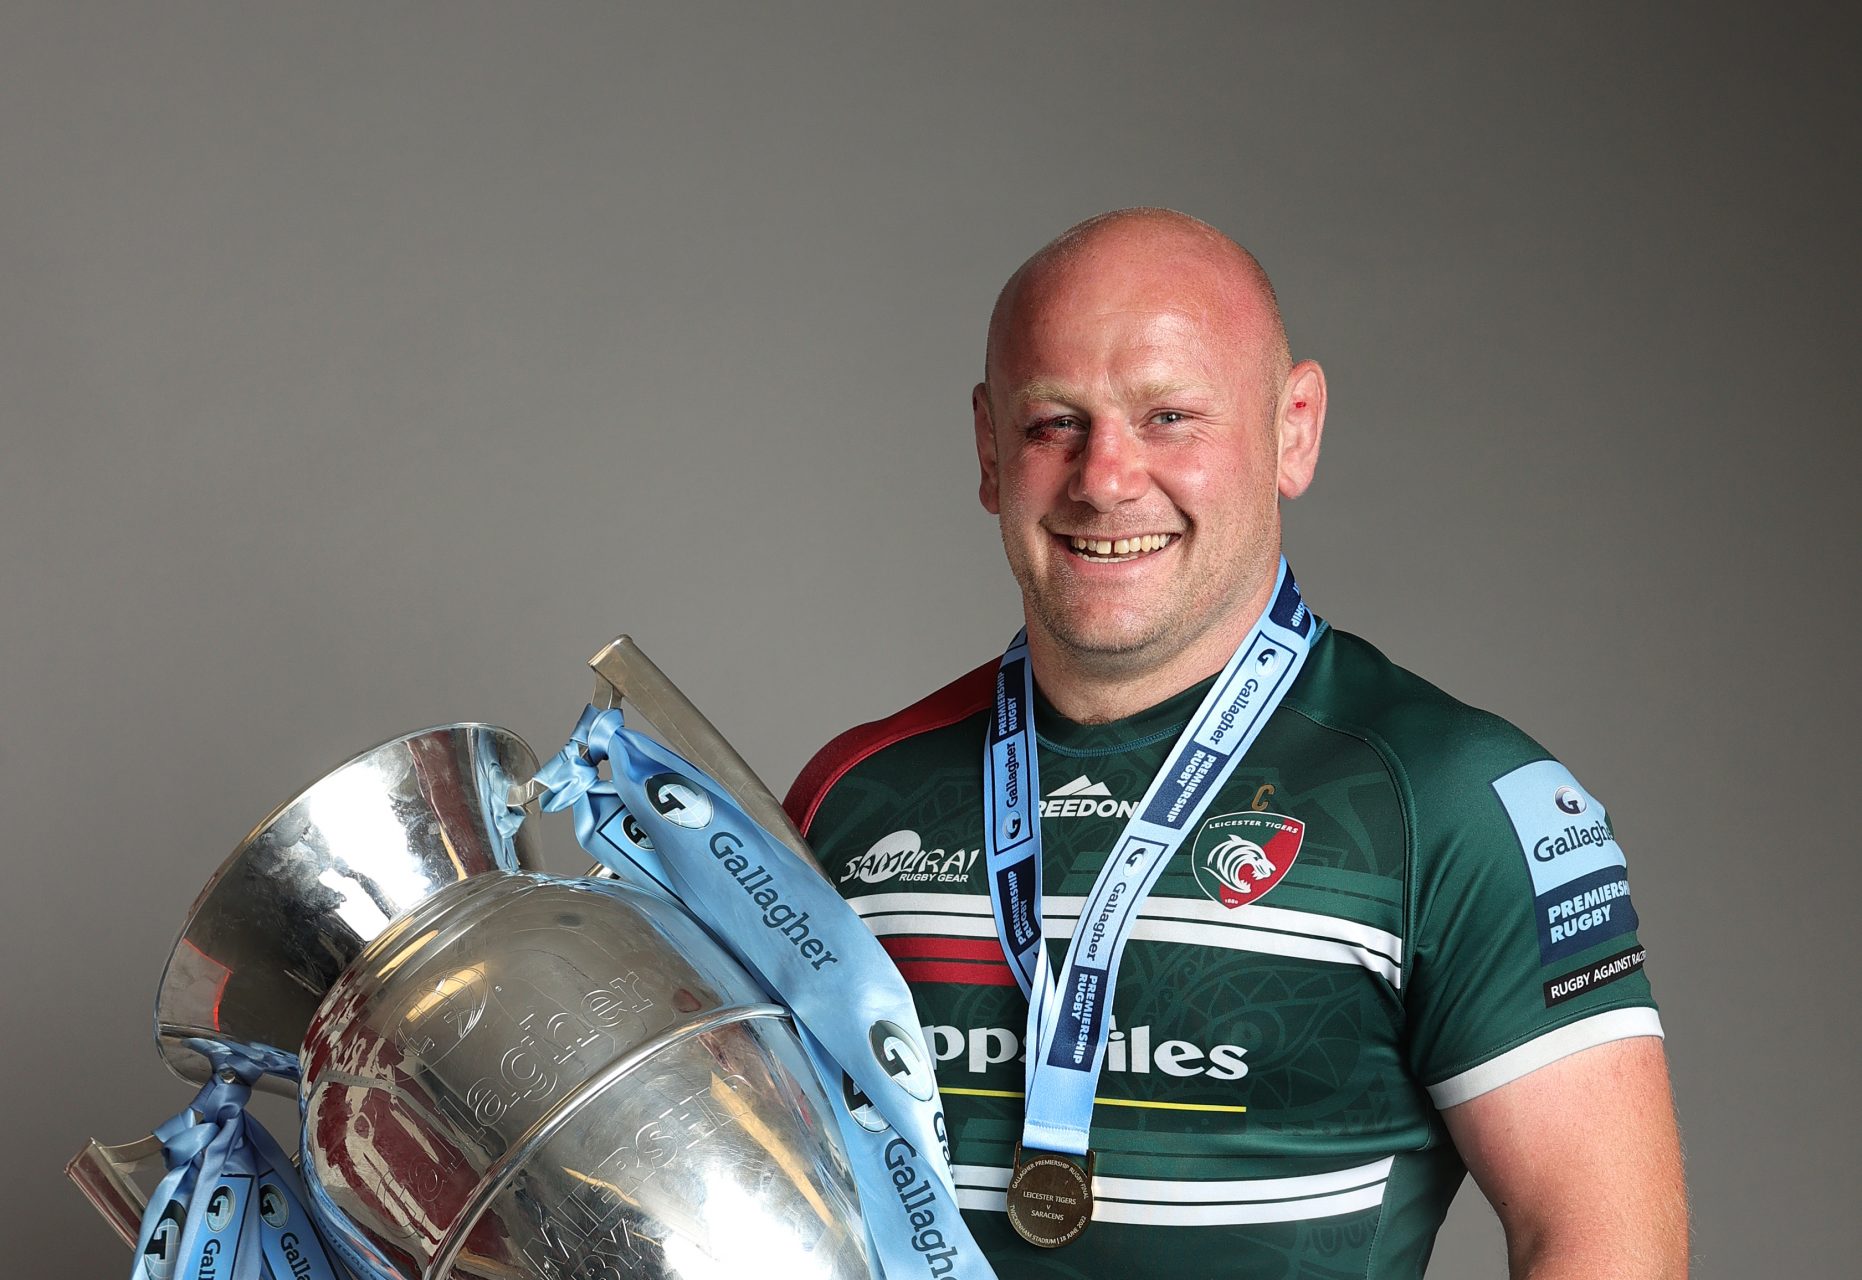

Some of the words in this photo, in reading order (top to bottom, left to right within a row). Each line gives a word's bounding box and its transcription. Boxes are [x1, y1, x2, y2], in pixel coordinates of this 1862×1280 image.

[997, 672, 1008, 736] PREMIERSHIP
[1007, 697, 1018, 732] RUGBY
[1209, 678, 1259, 745] Gallagher
[1005, 742, 1019, 808] Gallagher
[1176, 749, 1206, 787] RUGBY
[1038, 799, 1140, 818] REEDON
[1166, 754, 1218, 823] PREMIERSHIP
[1251, 784, 1276, 811] C
[1209, 820, 1262, 830] LEICESTER
[1265, 822, 1299, 834] TIGERS
[1533, 820, 1613, 862] Gallagh
[840, 848, 980, 883] SAMURAI
[898, 873, 937, 882] RUGBY
[937, 874, 969, 882] GEAR
[709, 831, 838, 970] Gallagher
[1008, 870, 1026, 946] PREMIERSHIP
[1020, 899, 1034, 939] RUGBY
[1086, 882, 1127, 962] Gallagher
[1549, 904, 1613, 944] RUGBY
[1071, 973, 1088, 1021] RUGBY
[1550, 972, 1591, 999] RUGBY
[1593, 956, 1632, 982] AGAINST
[1072, 975, 1098, 1064] PREMIERSHIP
[1108, 1016, 1249, 1080] iles
[1012, 1163, 1036, 1189] GALLAGHER
[1034, 1160, 1070, 1170] PREMIERSHIP
[1069, 1167, 1083, 1186] RUGBY
[1080, 1184, 1090, 1200] FINAL
[1023, 1191, 1054, 1202] LEICESTER
[1055, 1196, 1077, 1205] TIGERS
[1030, 1210, 1064, 1220] SARACENS
[1032, 1234, 1056, 1244] STADIUM
[1066, 1228, 1080, 1240] JUNE
